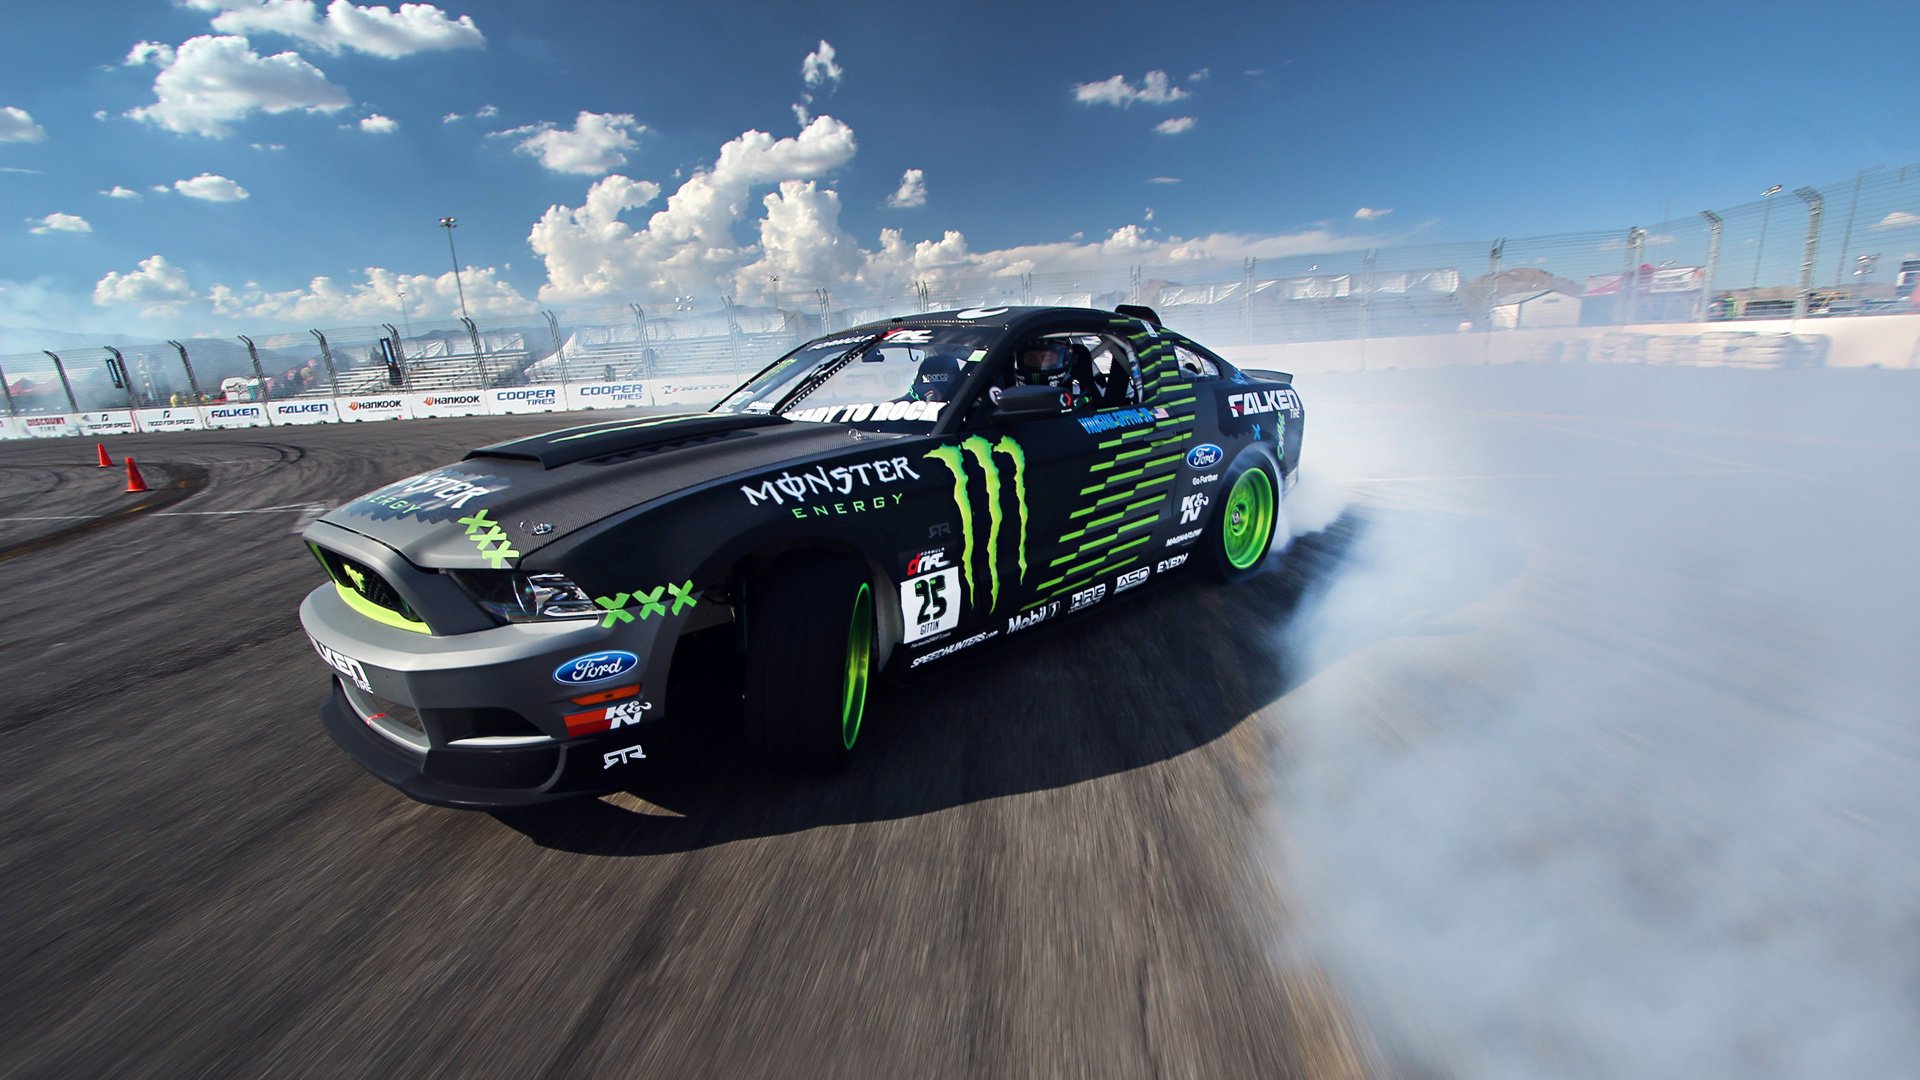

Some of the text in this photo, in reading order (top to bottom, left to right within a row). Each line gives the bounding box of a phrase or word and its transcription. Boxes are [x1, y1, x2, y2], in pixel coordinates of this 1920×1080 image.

[497, 389, 556, 401] COOPER
[580, 384, 643, 396] COOPER
[611, 393, 643, 401] TIRES
[211, 407, 259, 418] FALKEN
[278, 403, 329, 414] FALKEN
[527, 398, 556, 406] TIRES
[839, 403, 874, 422] TO
[869, 400, 948, 422] ROCK
[1228, 389, 1300, 417] FALKEN
[792, 493, 903, 519] ENERGY
[914, 575, 947, 626] 25
[1006, 606, 1047, 635] Mobil
[572, 655, 623, 681] Ford
[604, 701, 652, 730] K&N
